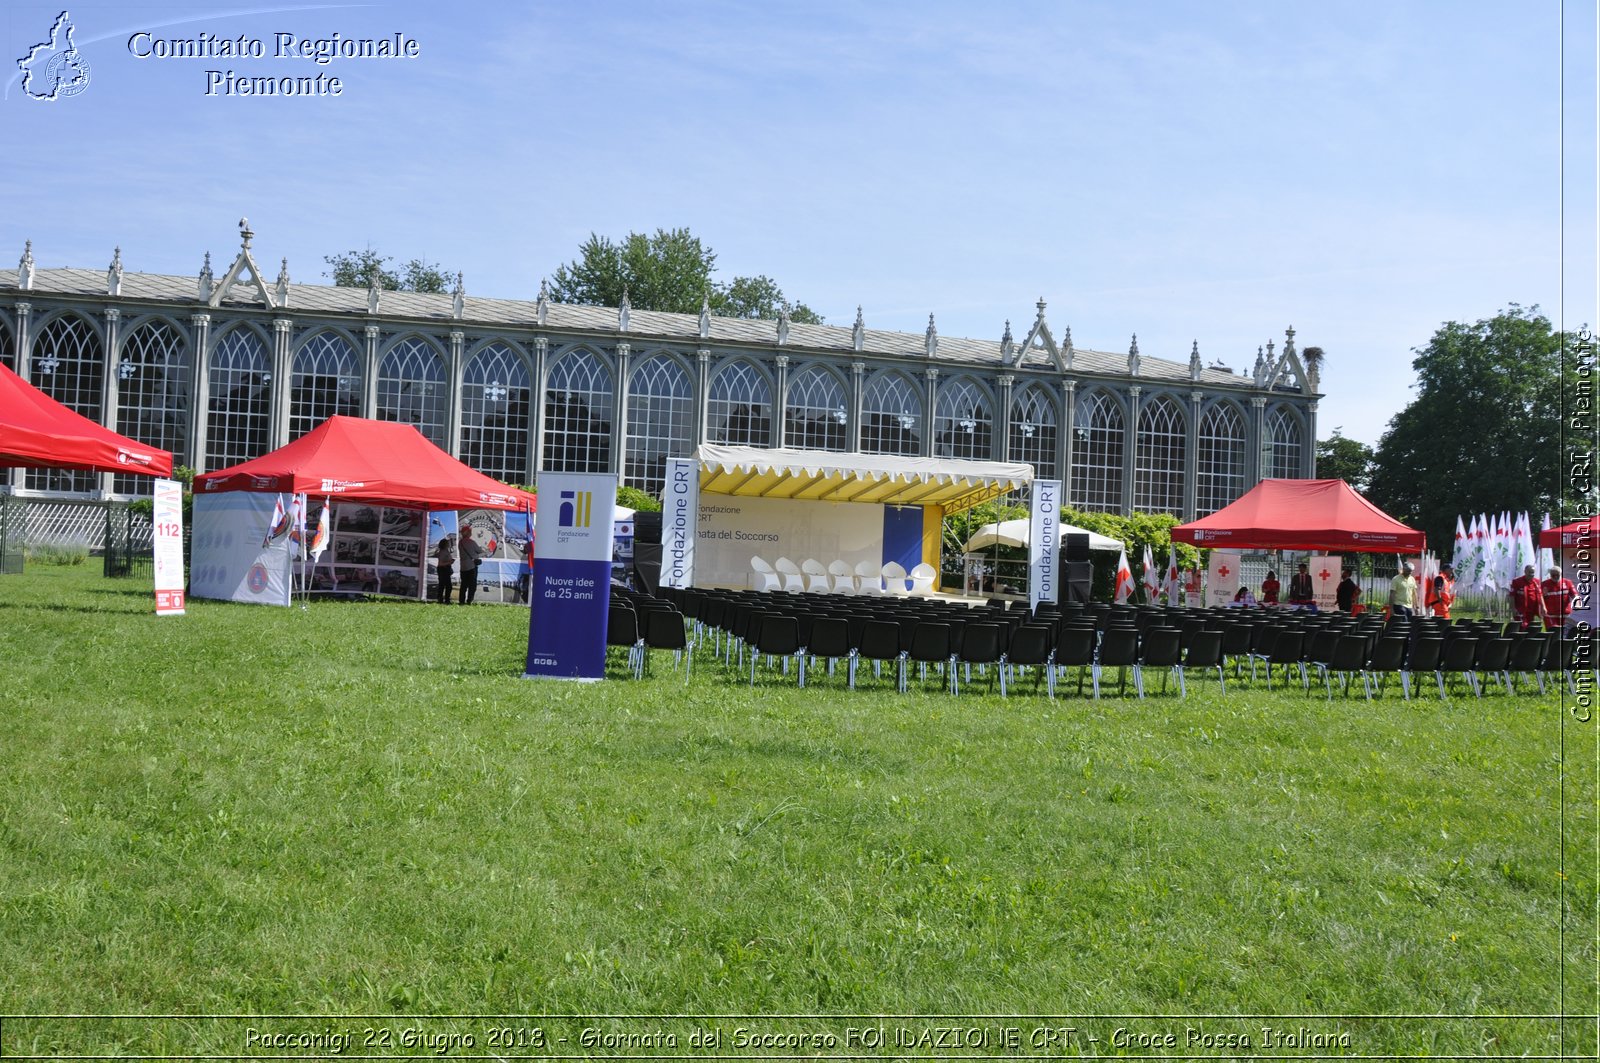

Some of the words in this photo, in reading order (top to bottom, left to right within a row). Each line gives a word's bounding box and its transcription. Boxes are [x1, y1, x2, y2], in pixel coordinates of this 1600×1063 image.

[674, 460, 690, 494] CRT
[1040, 482, 1054, 513] CRT
[157, 522, 180, 537] 112
[557, 530, 590, 538] Fondazione
[717, 530, 732, 540] del
[735, 531, 779, 542] Soccorso
[668, 499, 688, 587] Fondazione
[1038, 517, 1053, 601] Fondazione
[545, 576, 574, 587] Nuove
[575, 577, 595, 588] idee
[544, 588, 557, 599] da
[558, 587, 572, 599] 25
[573, 590, 594, 600] anni
